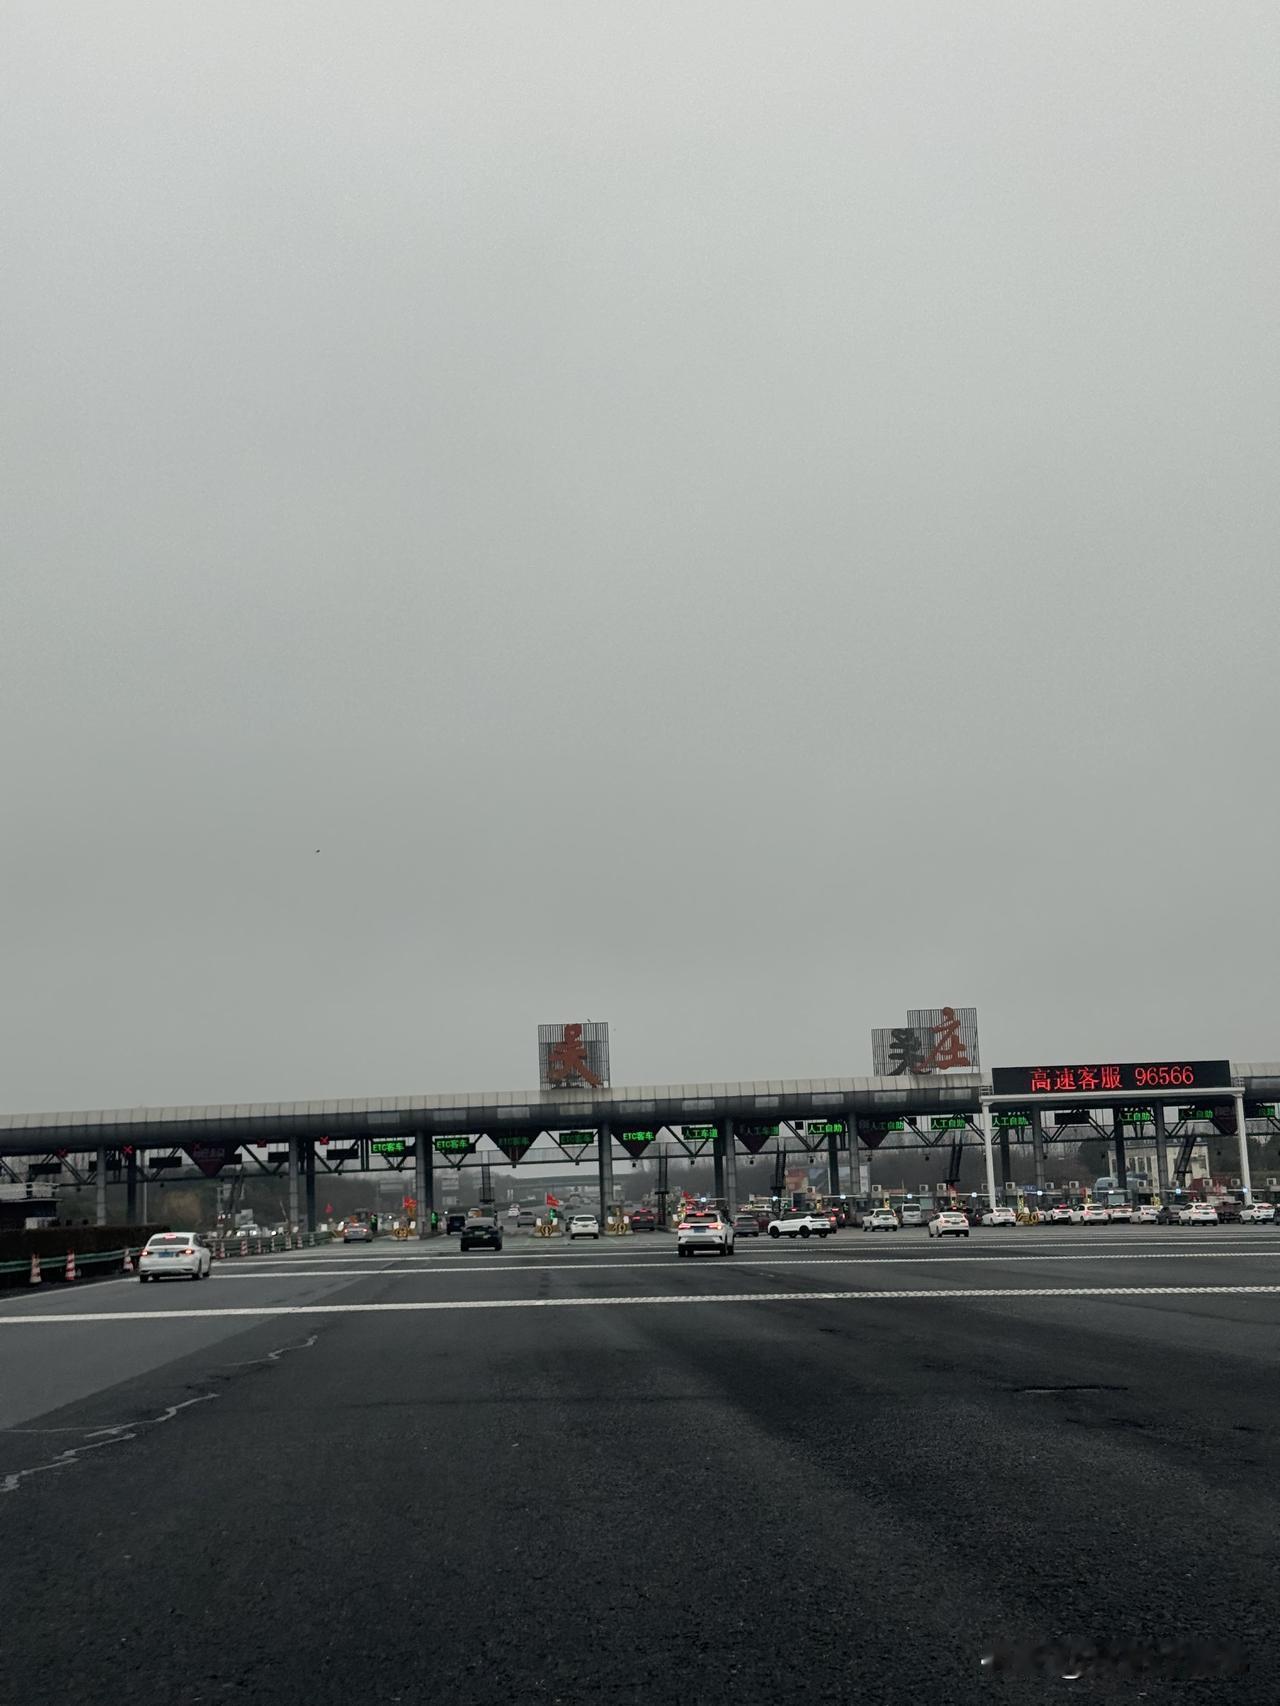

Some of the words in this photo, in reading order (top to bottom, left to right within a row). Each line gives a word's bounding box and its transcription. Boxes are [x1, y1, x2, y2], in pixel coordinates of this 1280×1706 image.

[1029, 1067, 1124, 1092] 高速客服
[1136, 1066, 1195, 1086] 96566
[931, 1119, 966, 1129] 人工自助
[992, 1117, 1028, 1127] 人工自助
[808, 1123, 843, 1134] 人工自助
[623, 1131, 654, 1141] ETC客车
[372, 1142, 404, 1152] ETC客车
[436, 1139, 468, 1149] ETC客车
